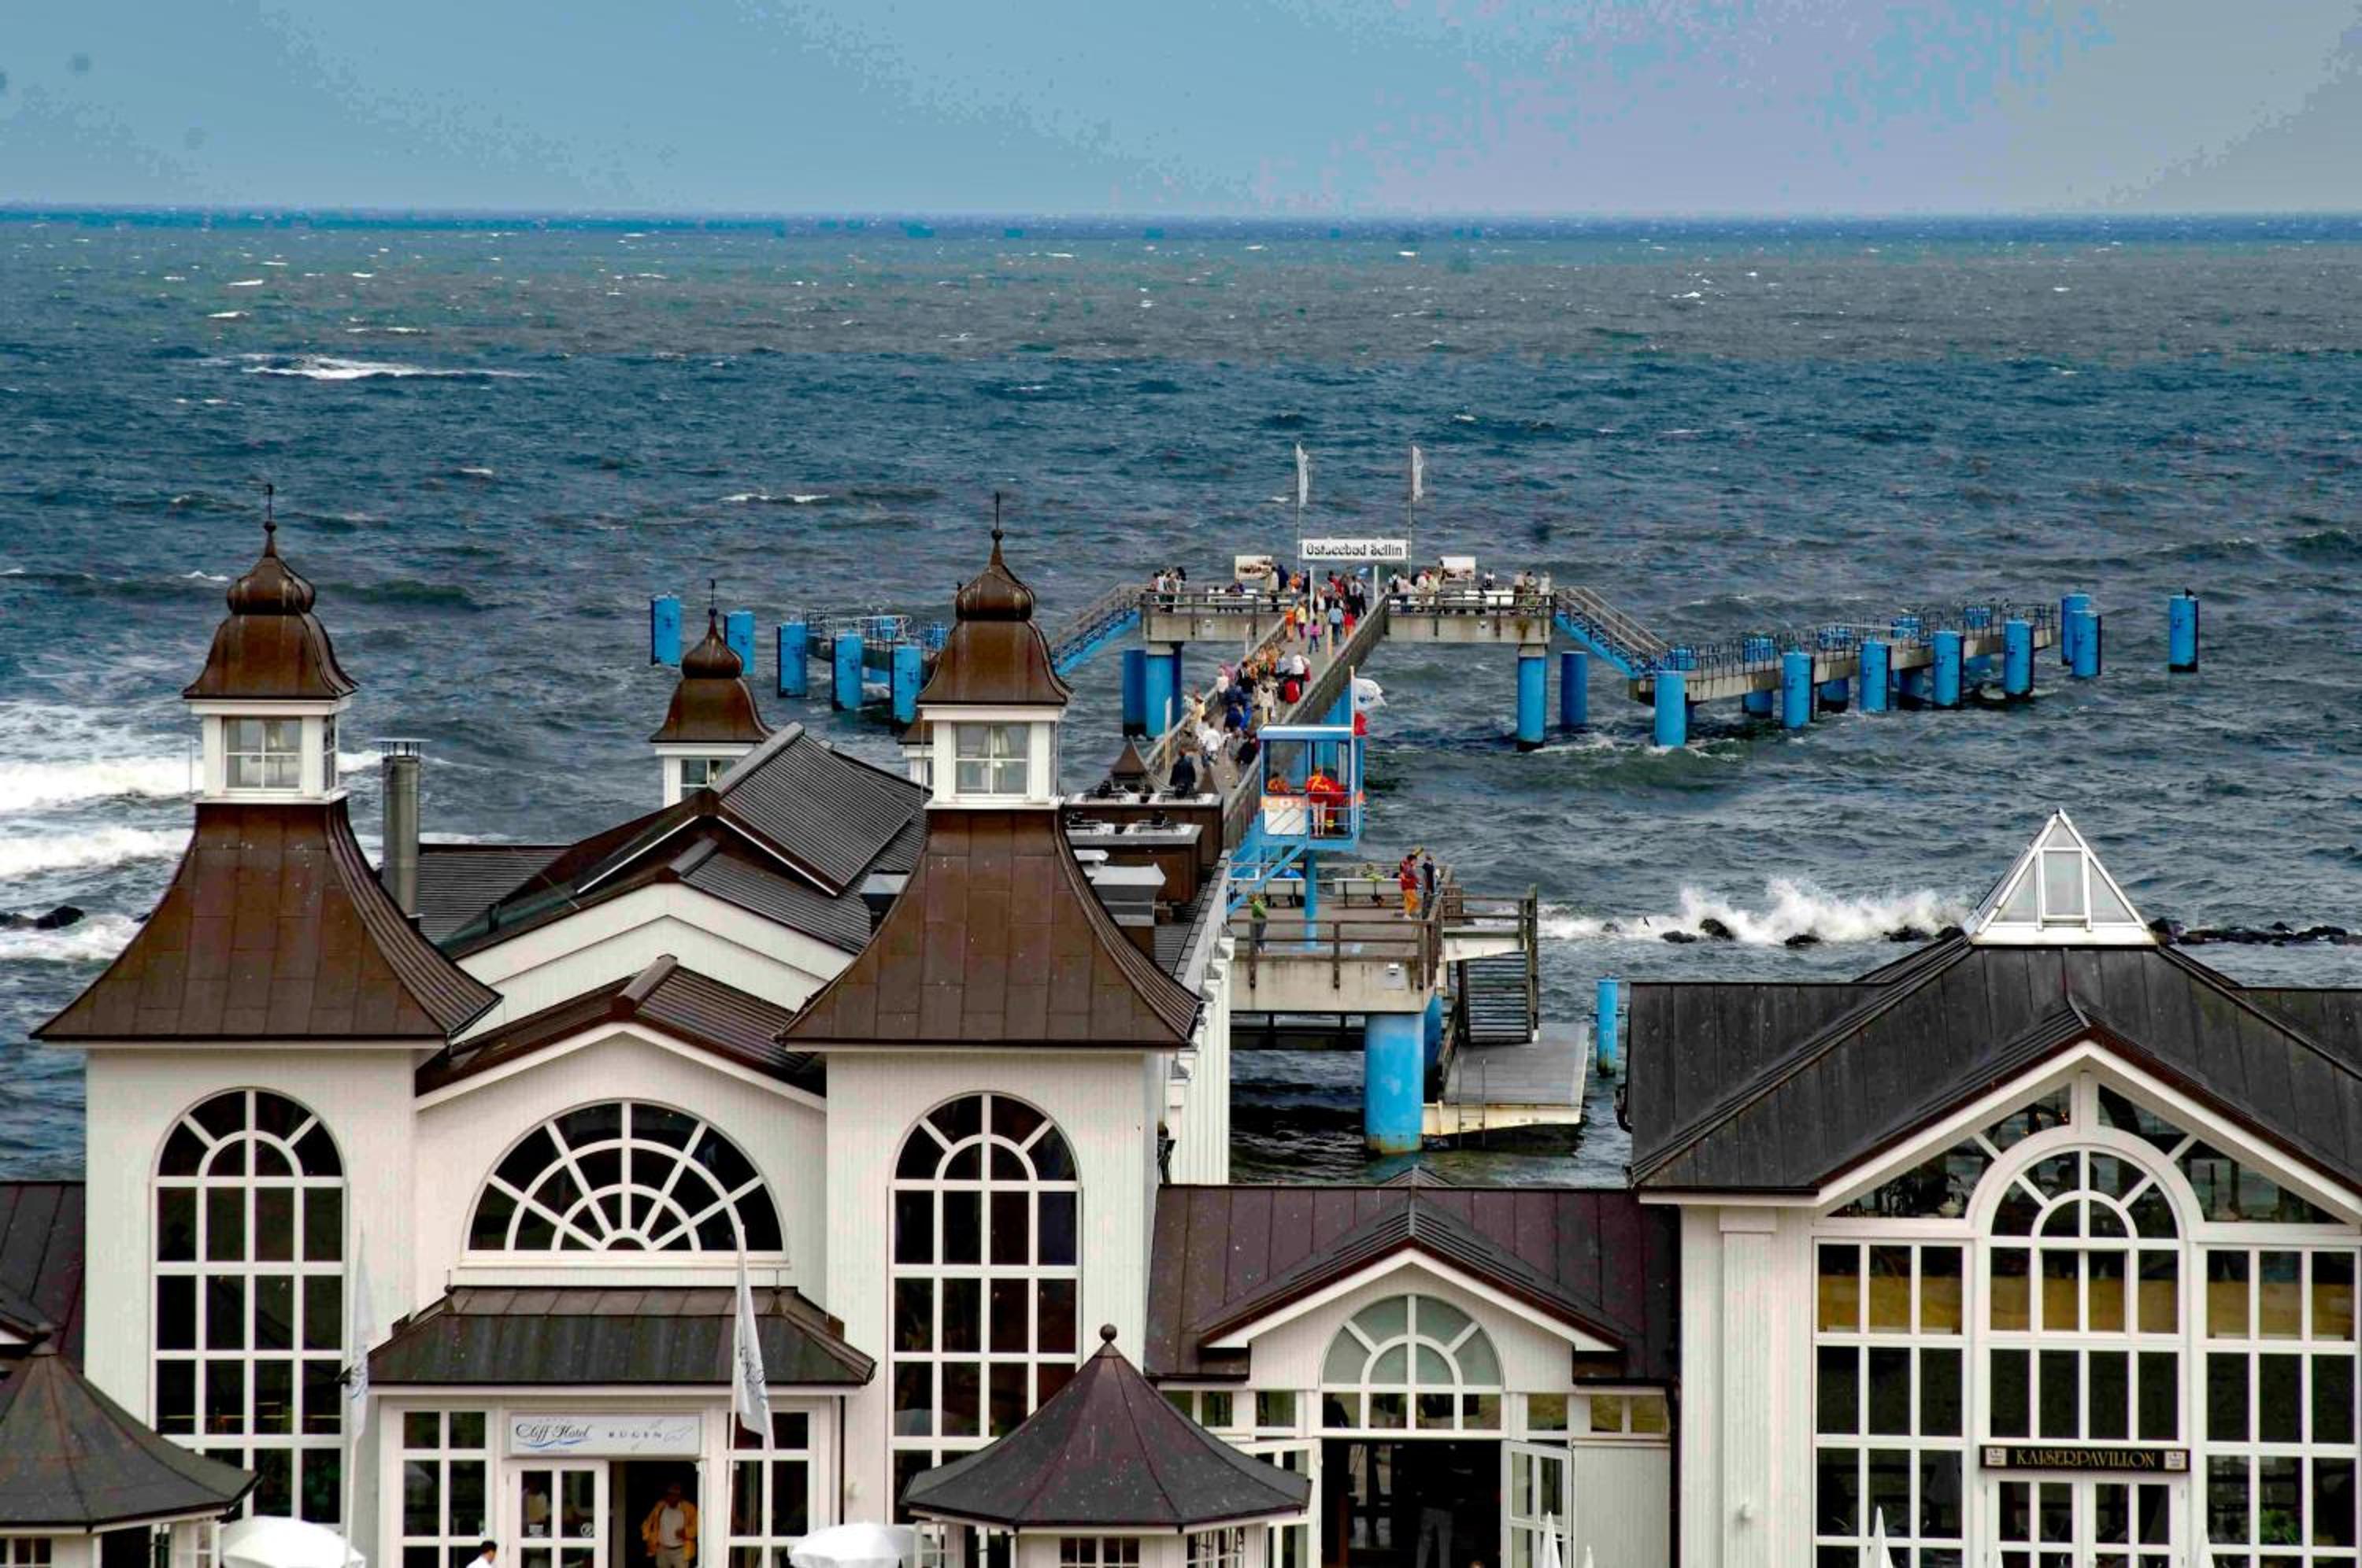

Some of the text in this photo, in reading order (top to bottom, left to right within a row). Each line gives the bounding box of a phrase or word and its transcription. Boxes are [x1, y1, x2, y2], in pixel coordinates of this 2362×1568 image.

[516, 1422, 592, 1442] Cliff Hotel
[2016, 1448, 2156, 1468] KAISERPAVILLON
